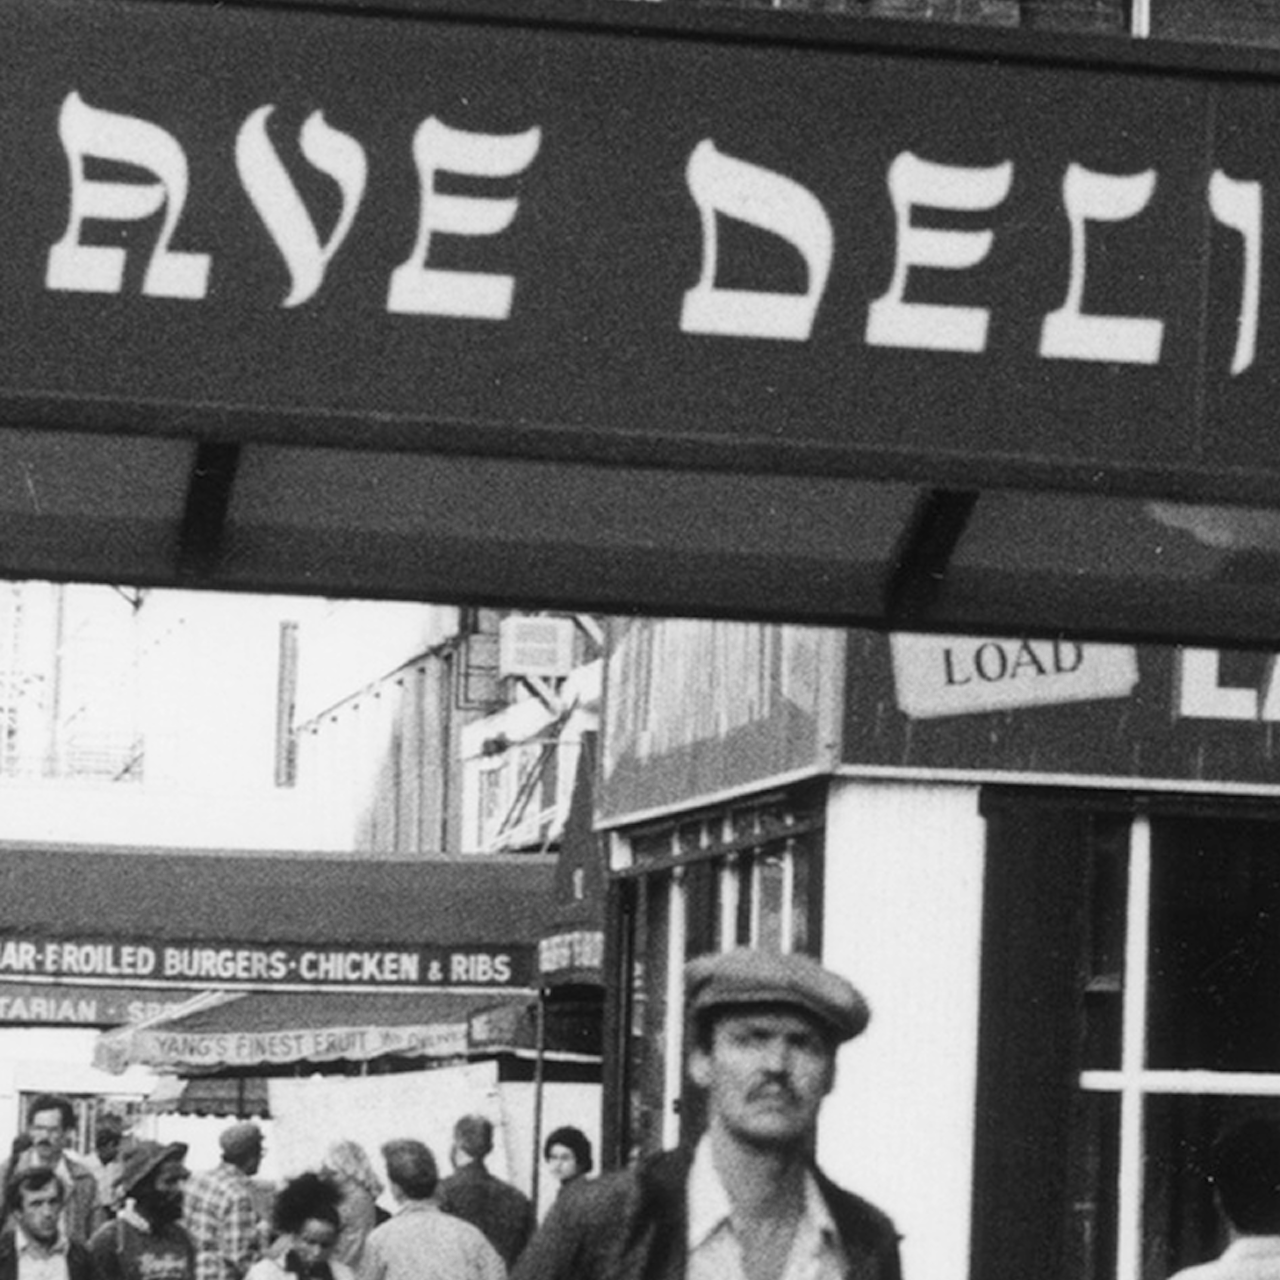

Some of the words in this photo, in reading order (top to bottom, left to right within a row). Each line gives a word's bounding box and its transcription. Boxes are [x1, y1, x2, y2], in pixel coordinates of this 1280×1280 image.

[45, 90, 542, 320] AVE
[680, 138, 1262, 374] DELI
[943, 640, 1084, 686] LOAD
[427, 960, 443, 982] &
[450, 953, 511, 982] RIBS
[235, 1032, 303, 1058] FINEST
